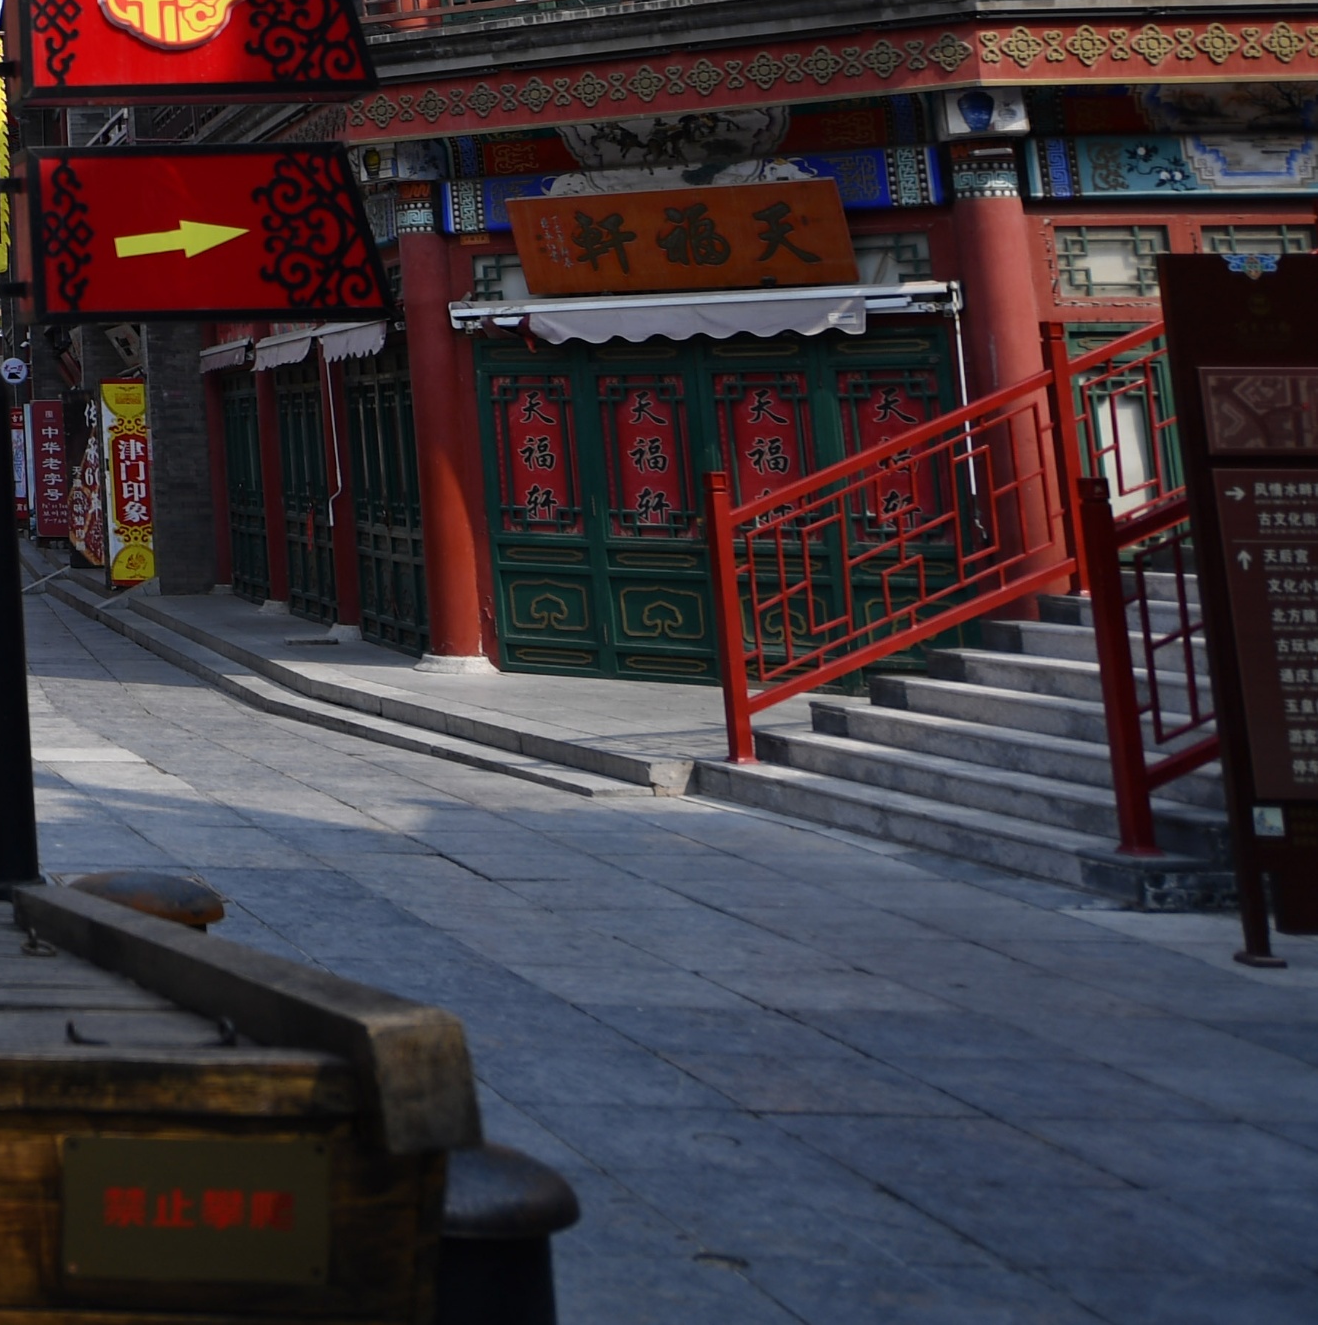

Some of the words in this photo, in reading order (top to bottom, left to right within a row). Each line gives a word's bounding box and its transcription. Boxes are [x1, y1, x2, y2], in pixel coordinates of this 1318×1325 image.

[41, 426, 64, 502] 中华老字号
[118, 439, 150, 524] 津门印象
[1253, 482, 1318, 497] 风情水畔
[1263, 548, 1309, 564] 天后宫
